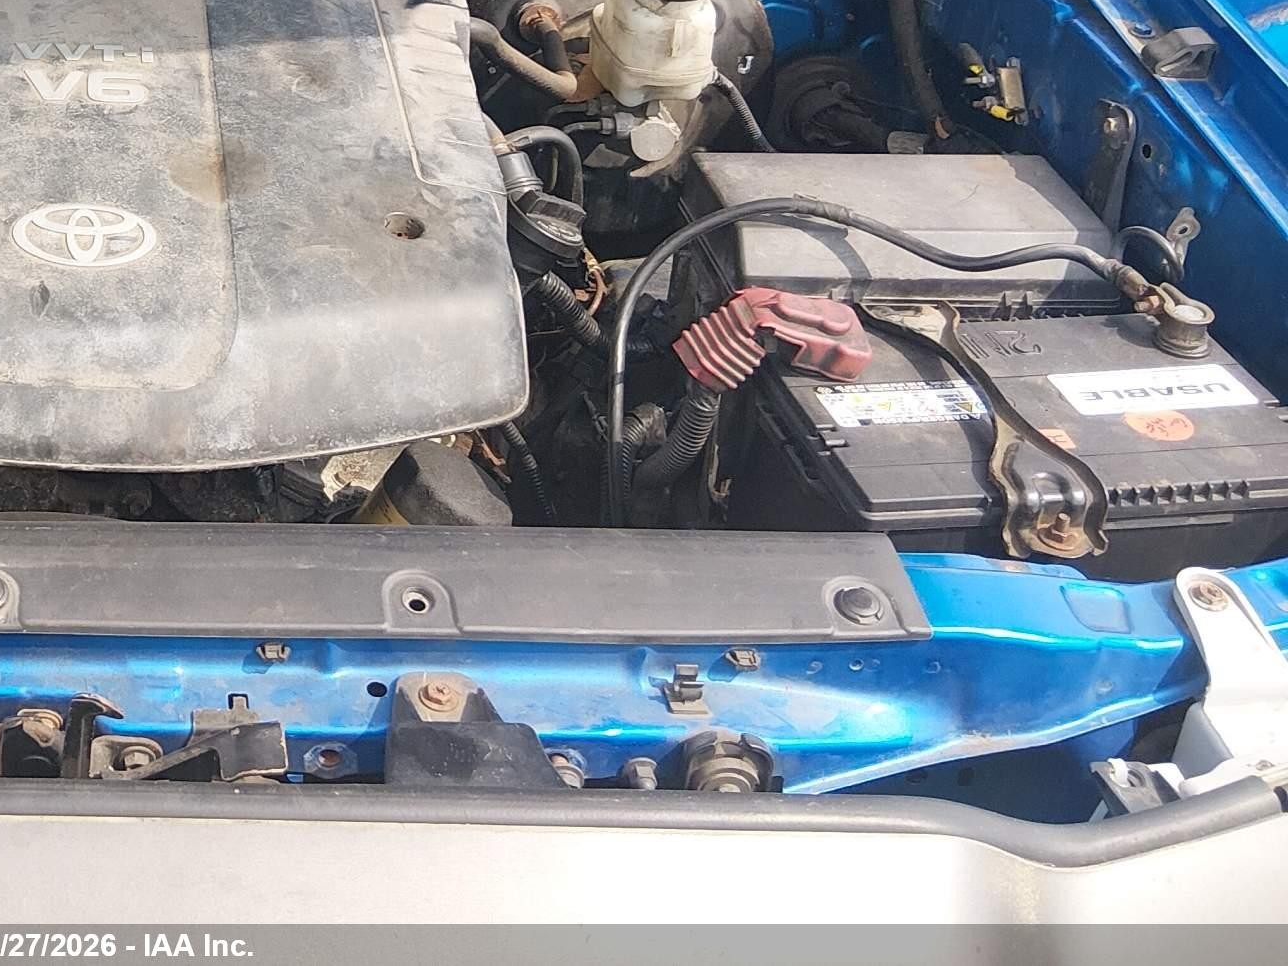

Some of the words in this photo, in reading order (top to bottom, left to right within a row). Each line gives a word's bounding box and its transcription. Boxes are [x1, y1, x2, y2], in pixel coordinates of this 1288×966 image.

[14, 42, 154, 63] VVT-i
[23, 69, 150, 104] V6
[1079, 381, 1231, 403] USABLE
